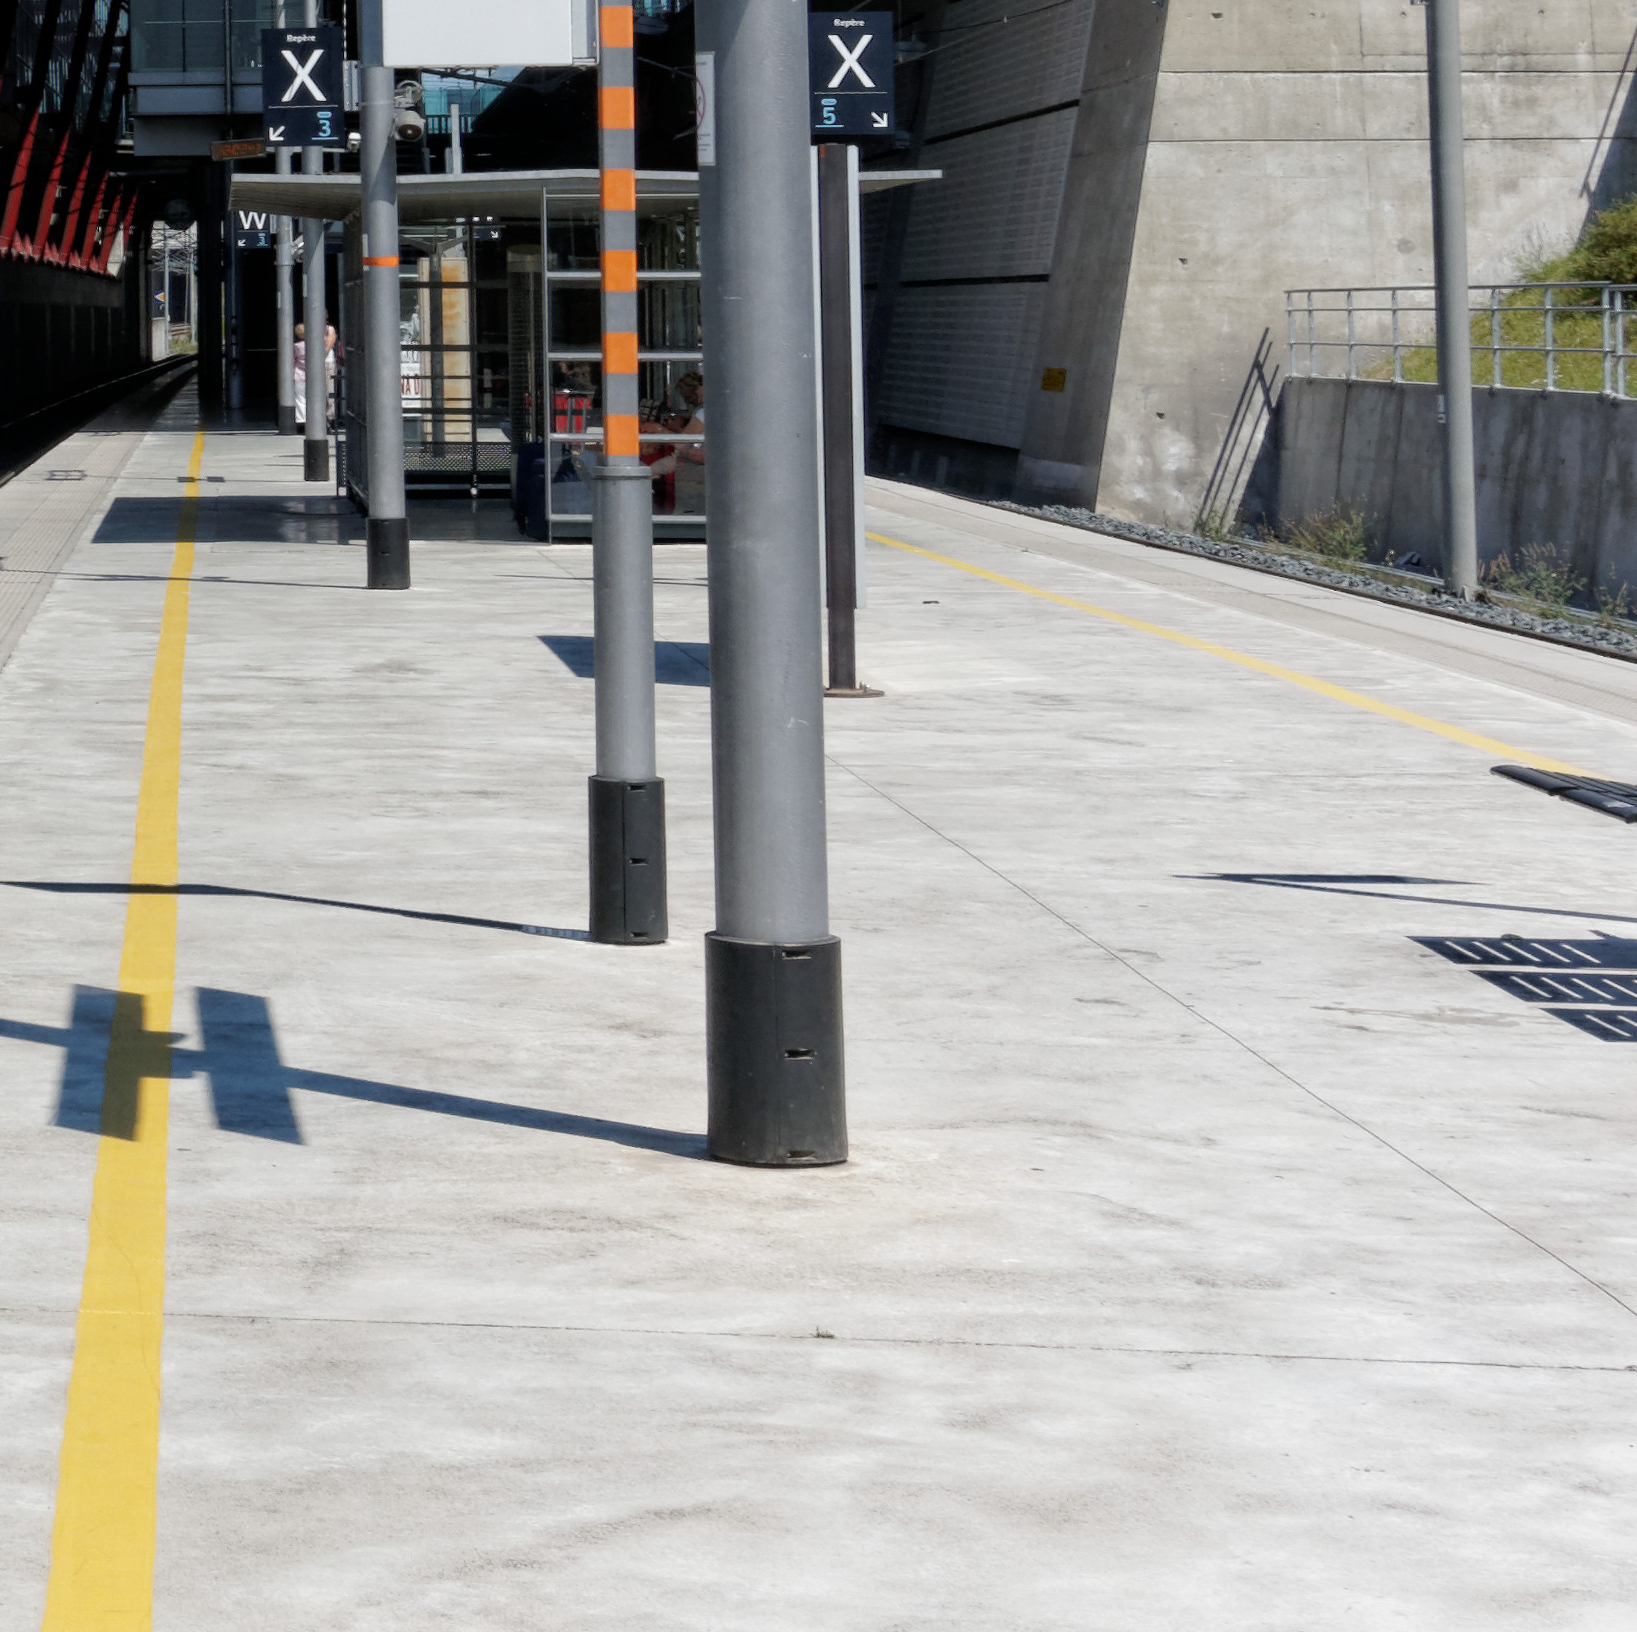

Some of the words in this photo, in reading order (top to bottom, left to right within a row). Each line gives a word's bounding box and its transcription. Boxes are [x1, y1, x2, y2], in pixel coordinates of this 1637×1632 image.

[827, 34, 876, 88] X
[281, 49, 327, 102] X
[823, 107, 837, 125] 5
[318, 119, 332, 137] 3
[238, 210, 267, 229] W
